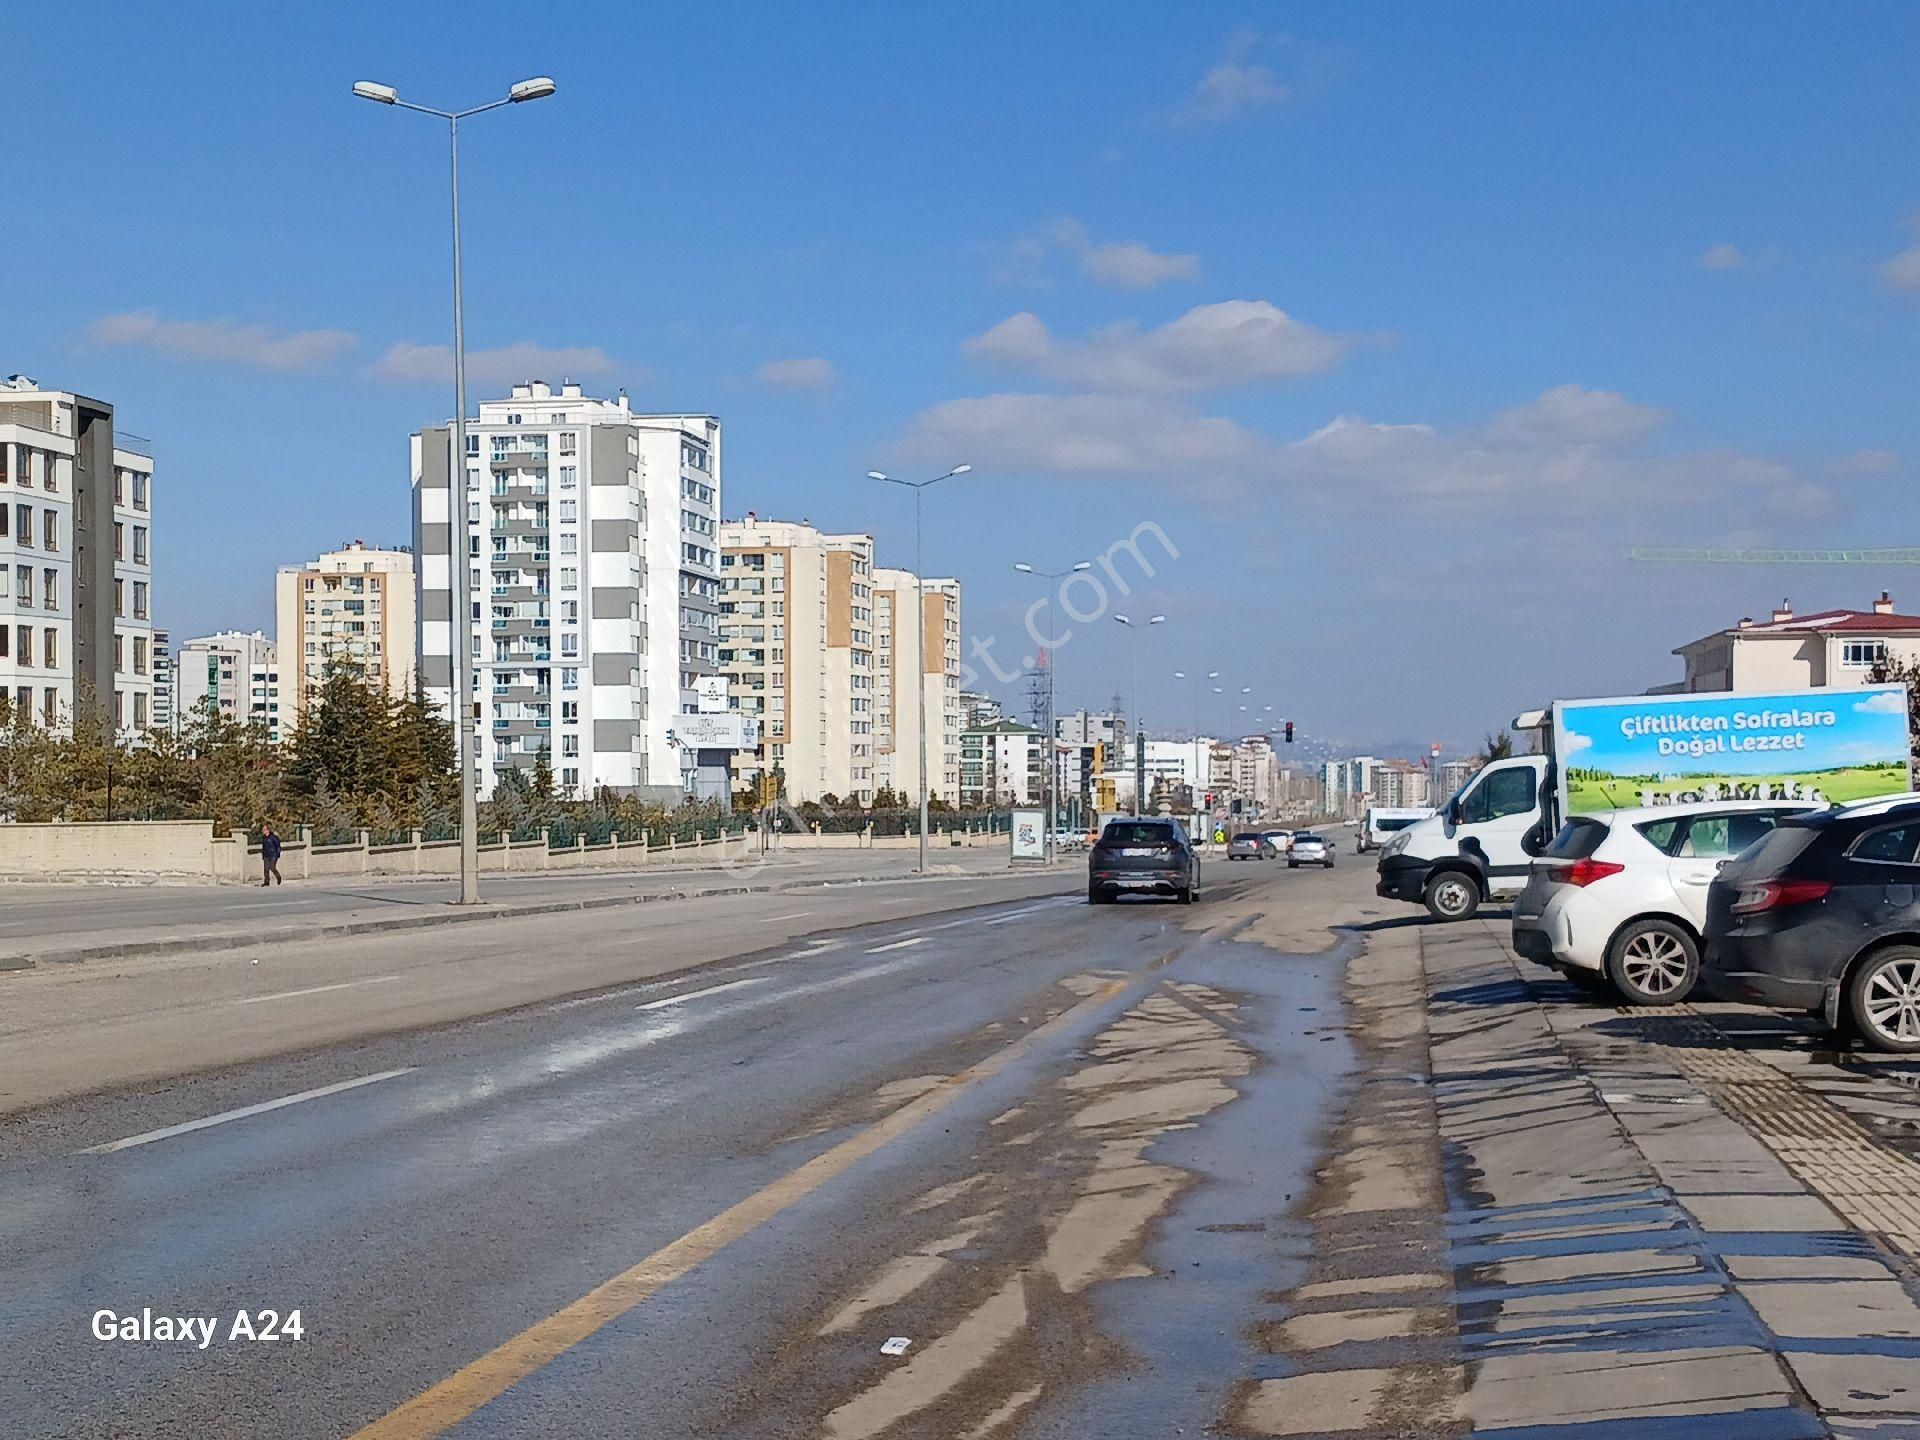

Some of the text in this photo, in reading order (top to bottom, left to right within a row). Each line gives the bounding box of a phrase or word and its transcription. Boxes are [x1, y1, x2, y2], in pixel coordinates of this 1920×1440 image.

[1621, 710, 1836, 739] Çiftlikten Sofralara
[1659, 733, 1805, 757] Doğal Lezzet
